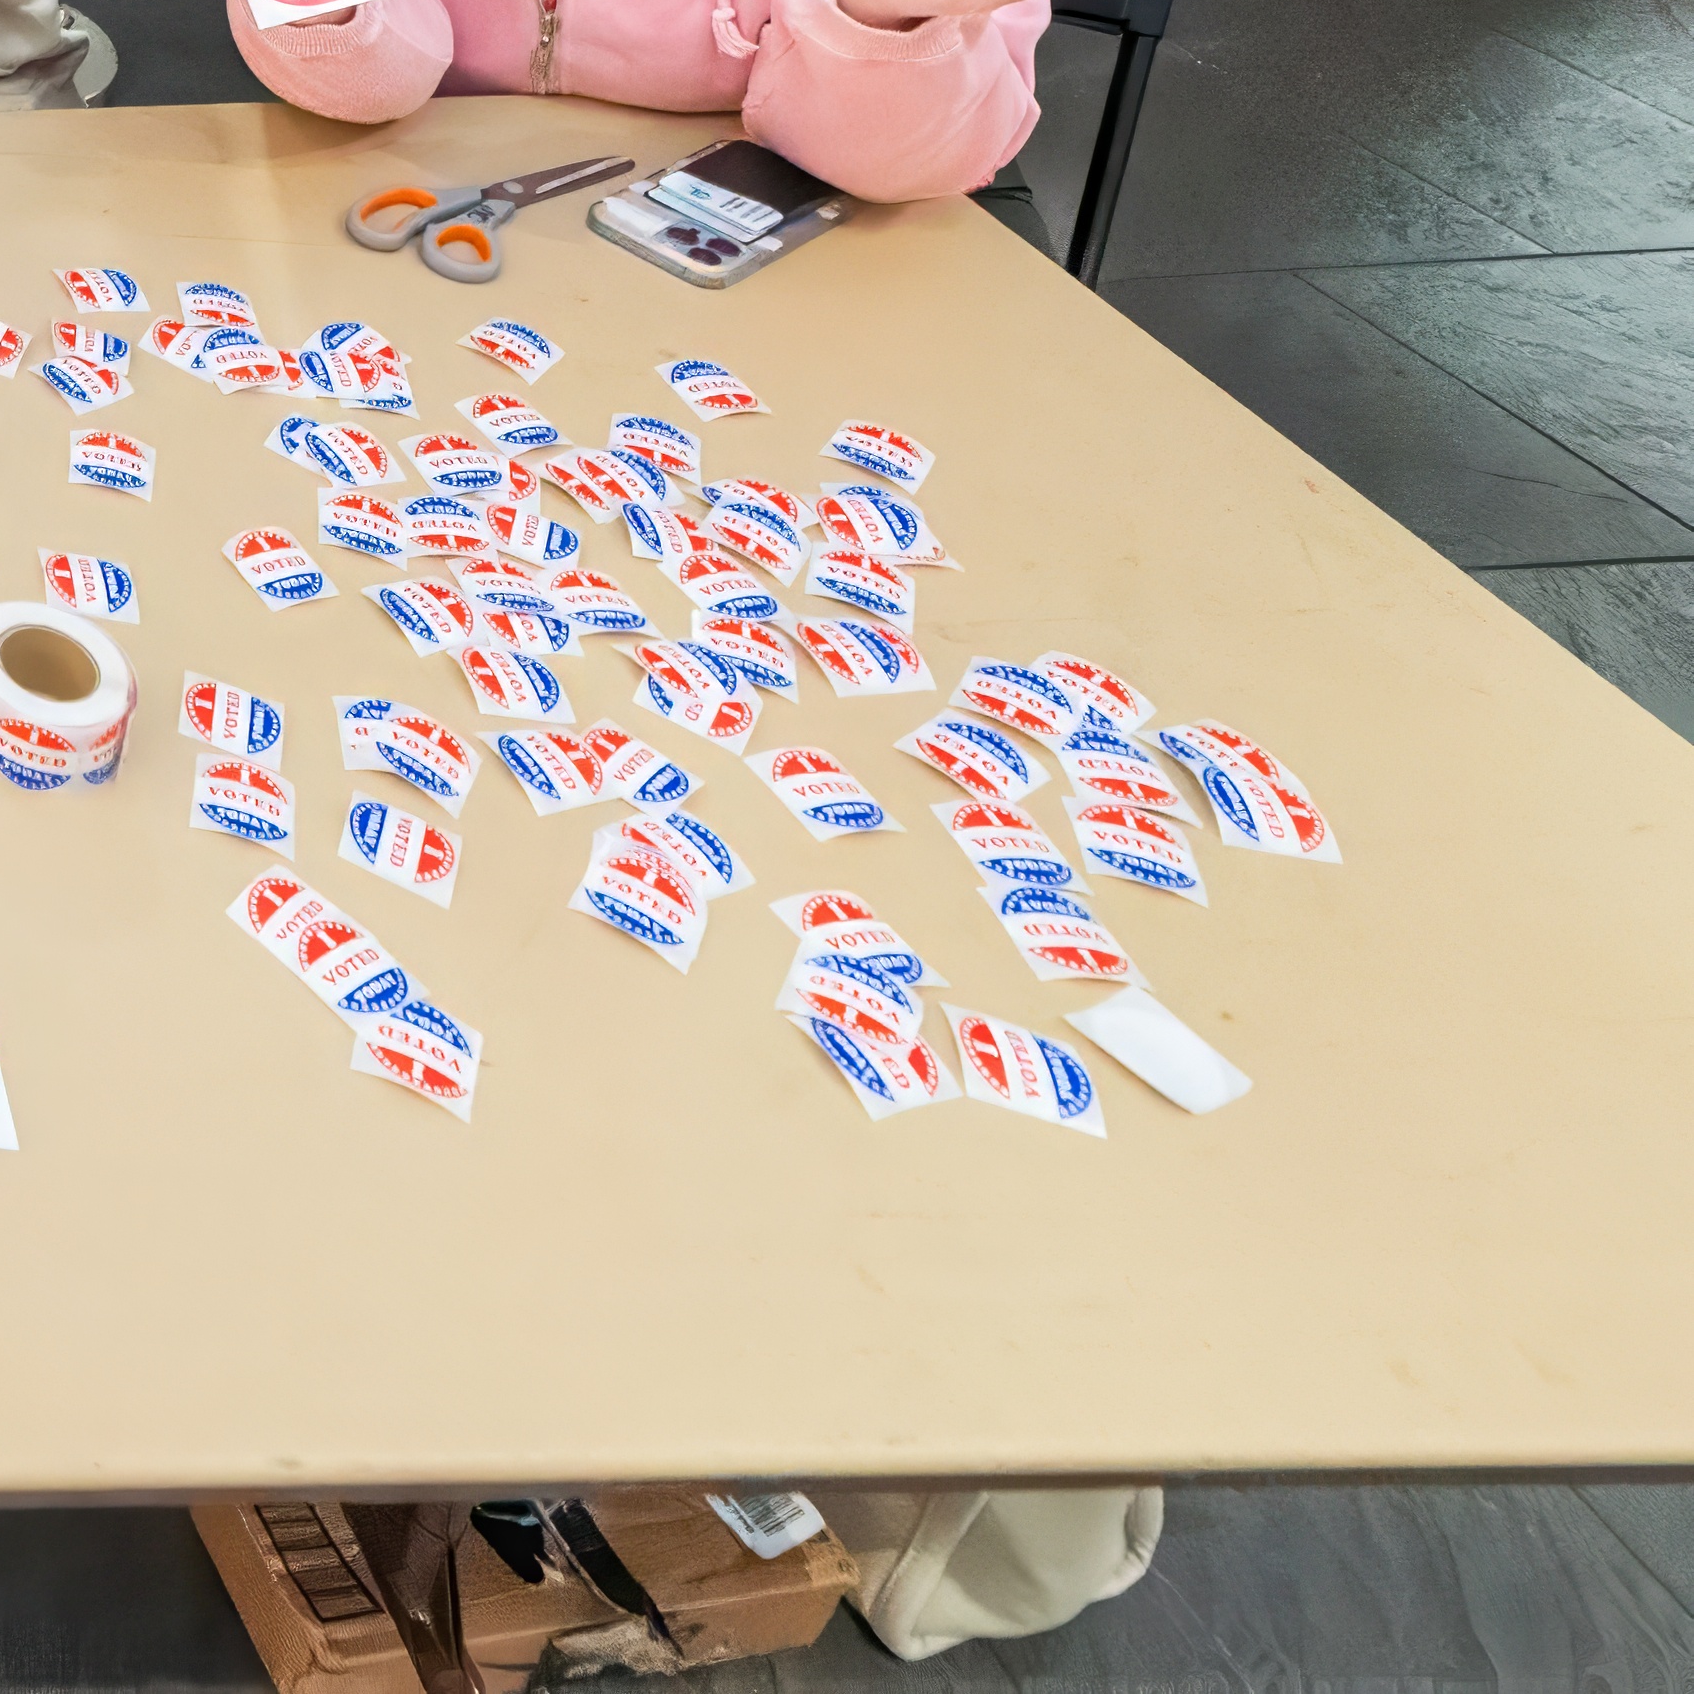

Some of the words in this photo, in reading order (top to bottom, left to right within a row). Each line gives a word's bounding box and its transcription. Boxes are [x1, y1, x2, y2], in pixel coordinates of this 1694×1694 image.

[216, 351, 269, 364] VOTED
[489, 412, 541, 427] VOTED
[521, 515, 539, 546] VOTED
[251, 554, 307, 576] VOTED
[699, 578, 757, 595] VOTED
[223, 691, 241, 740] VOTED
[1077, 757, 1161, 782] VOTED
[207, 786, 281, 818] VOTED
[792, 782, 860, 798] VOTED
[389, 817, 414, 868] VOTED
[972, 837, 1050, 854] VOTED
[1093, 830, 1182, 865] VOTED
[602, 875, 683, 926] VOTED
[276, 900, 324, 941] VOTED
[1023, 923, 1108, 944] VOTED
[824, 931, 896, 950] VOTED
[322, 948, 380, 986] VOTED
[809, 975, 900, 1026] VOTED
[378, 1023, 463, 1074] VOTED
[1004, 1029, 1040, 1098] VOTED
